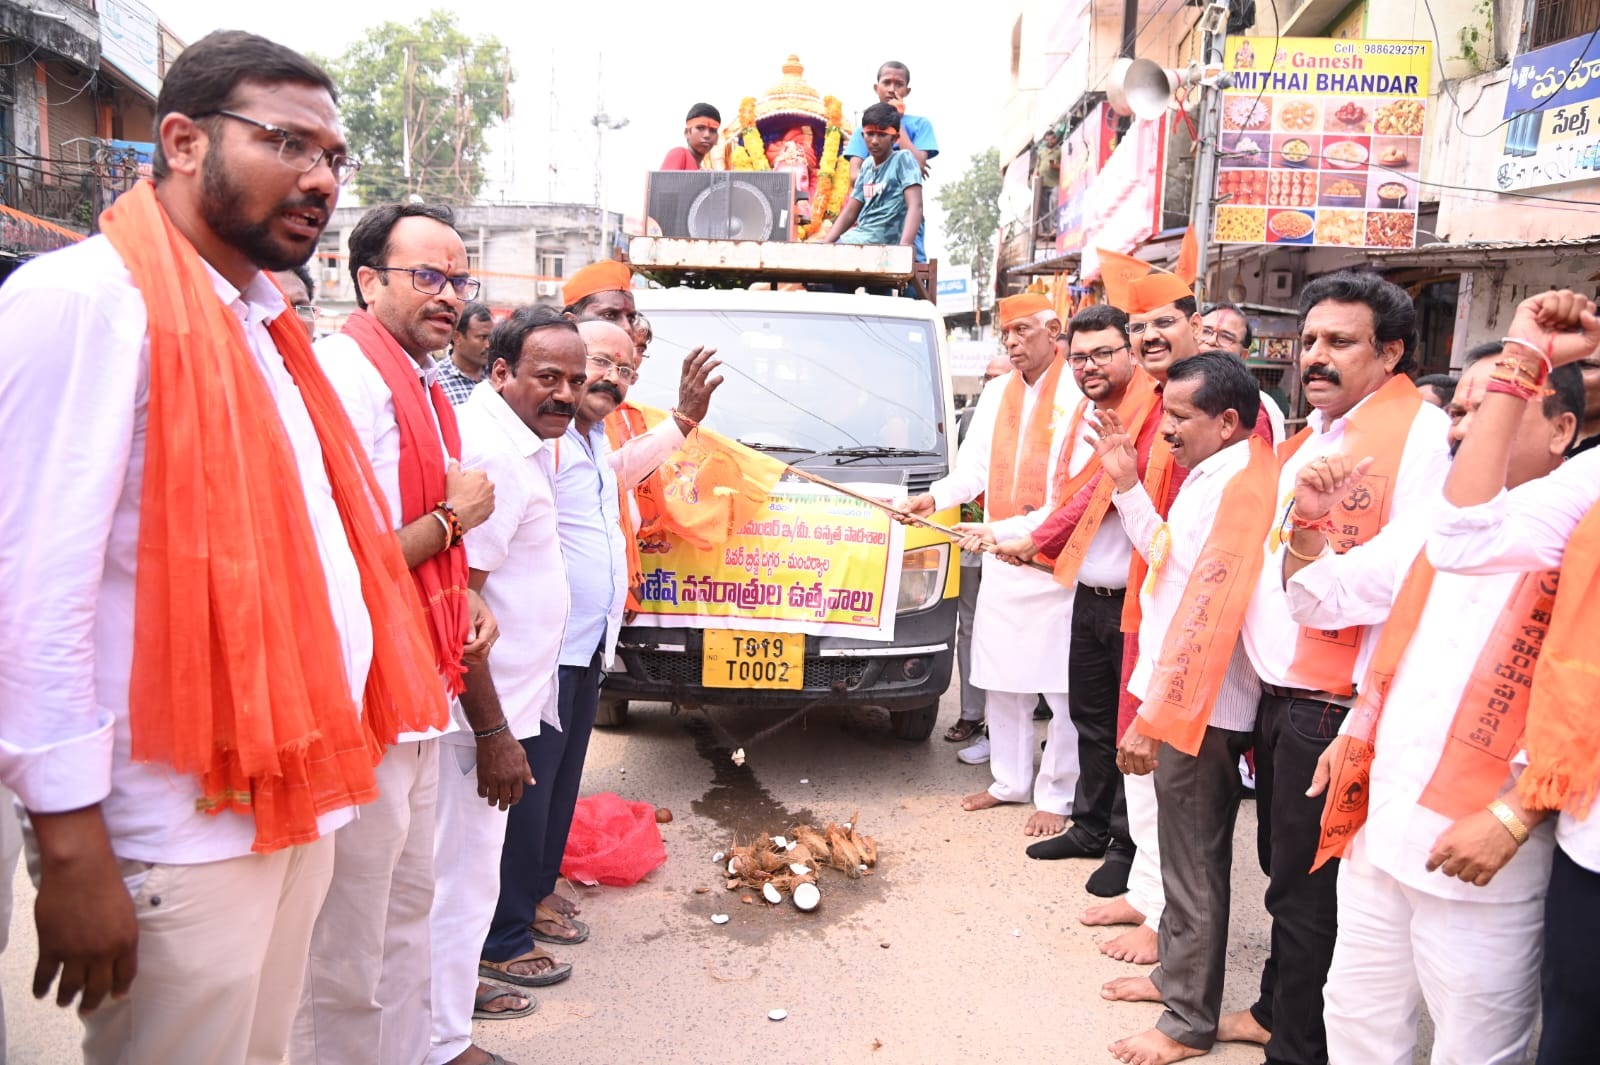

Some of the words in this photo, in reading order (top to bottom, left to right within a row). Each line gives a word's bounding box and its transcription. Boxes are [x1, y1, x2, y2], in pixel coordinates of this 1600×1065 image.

[1334, 43, 1355, 54] Cell
[1364, 44, 1426, 55] 9886292571
[1292, 52, 1363, 70] Ganesh
[1233, 71, 1308, 91] MITHAI
[1316, 73, 1418, 94] BHANDAR
[736, 519, 781, 537] మందిర్
[682, 574, 782, 610] నవరాత్రుల
[788, 581, 874, 617] ఉత్సవాలు
[726, 660, 790, 682] T0002
